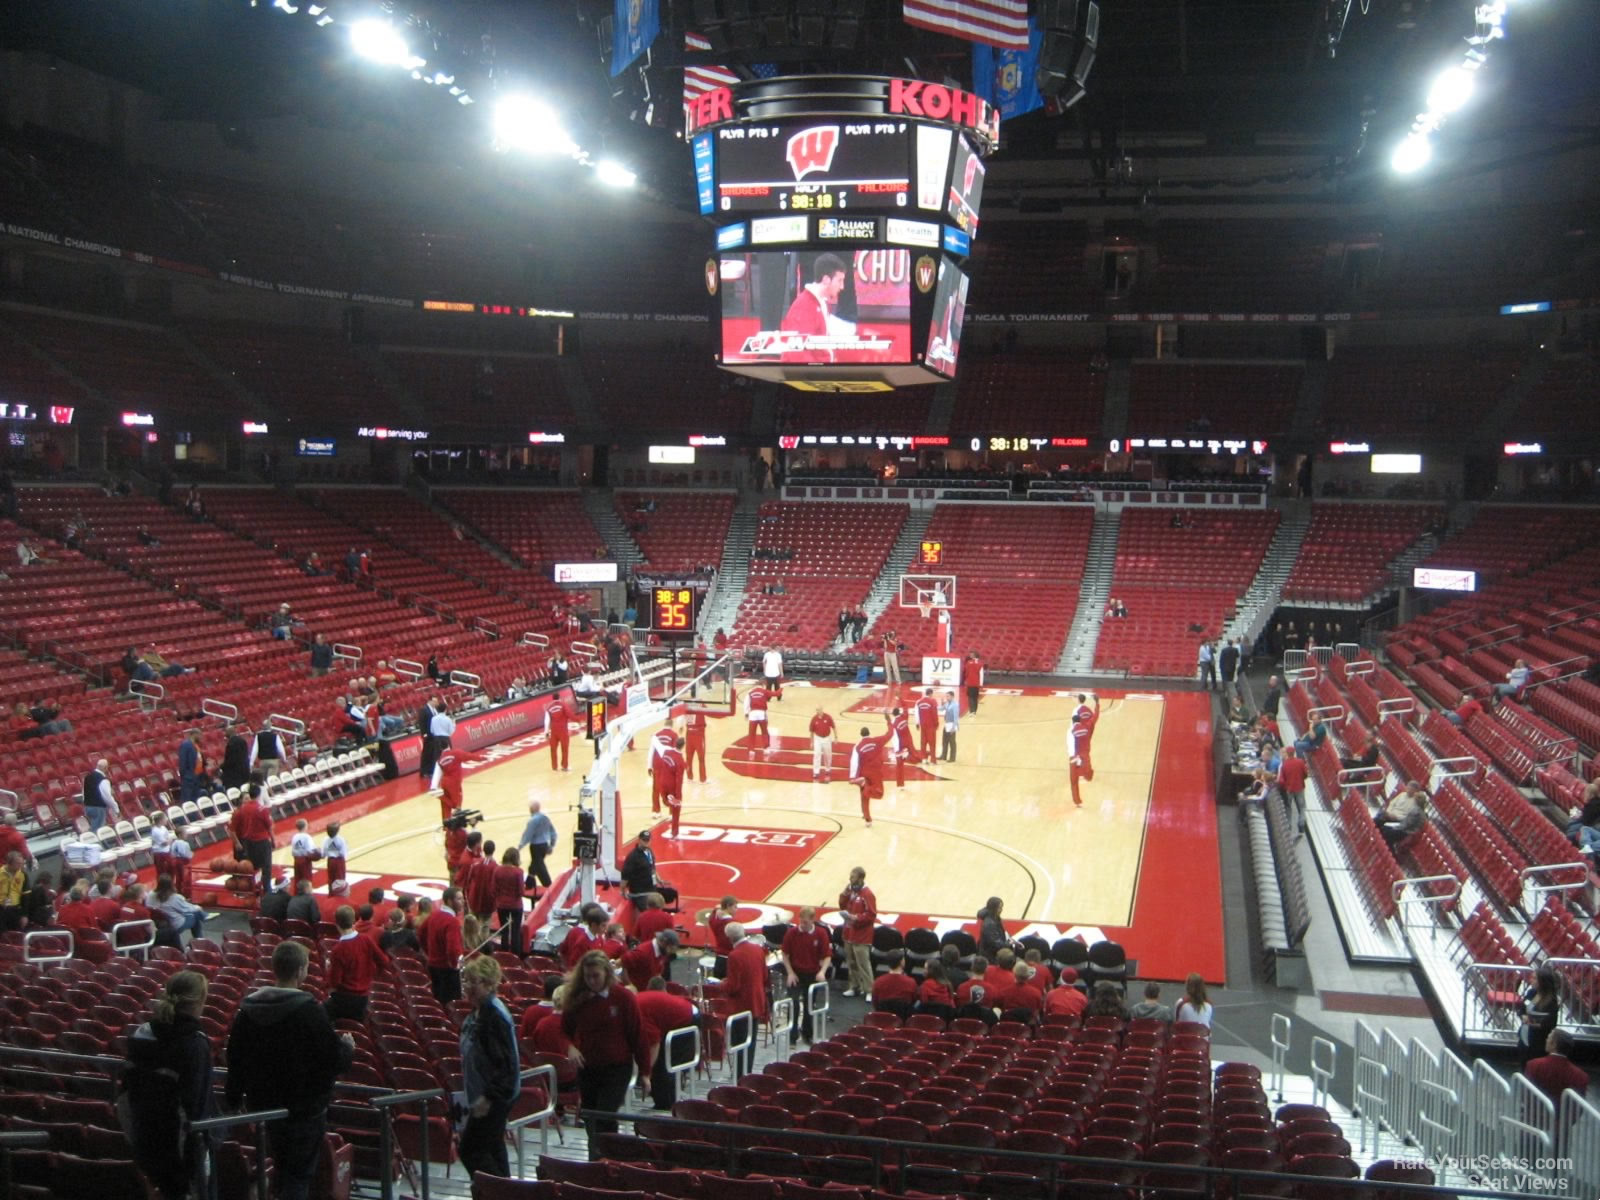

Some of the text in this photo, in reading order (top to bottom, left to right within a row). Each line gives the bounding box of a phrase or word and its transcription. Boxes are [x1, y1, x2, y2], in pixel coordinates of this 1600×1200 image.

[857, 183, 909, 194] FALCONS
[721, 196, 731, 211] 0
[896, 194, 907, 207] 0
[837, 220, 875, 230] ALLIANT
[837, 228, 875, 239] ENERGY
[7, 224, 60, 244] NATIONAL
[63, 236, 121, 257] CHAMPIONS
[277, 283, 348, 299] TOURNAMENT
[974, 314, 1006, 322] NCAA
[1009, 314, 1089, 322] TOURNAMENT
[388, 430, 412, 440] serving
[971, 438, 980, 451] 0
[989, 437, 1029, 451] 38:18
[1052, 438, 1087, 446] FALCONS
[1110, 439, 1119, 453] 0
[656, 590, 690, 603] 38:18
[661, 604, 686, 627] 35
[932, 658, 952, 672] yp
[464, 723, 482, 741] Your
[481, 717, 502, 735] Ticket
